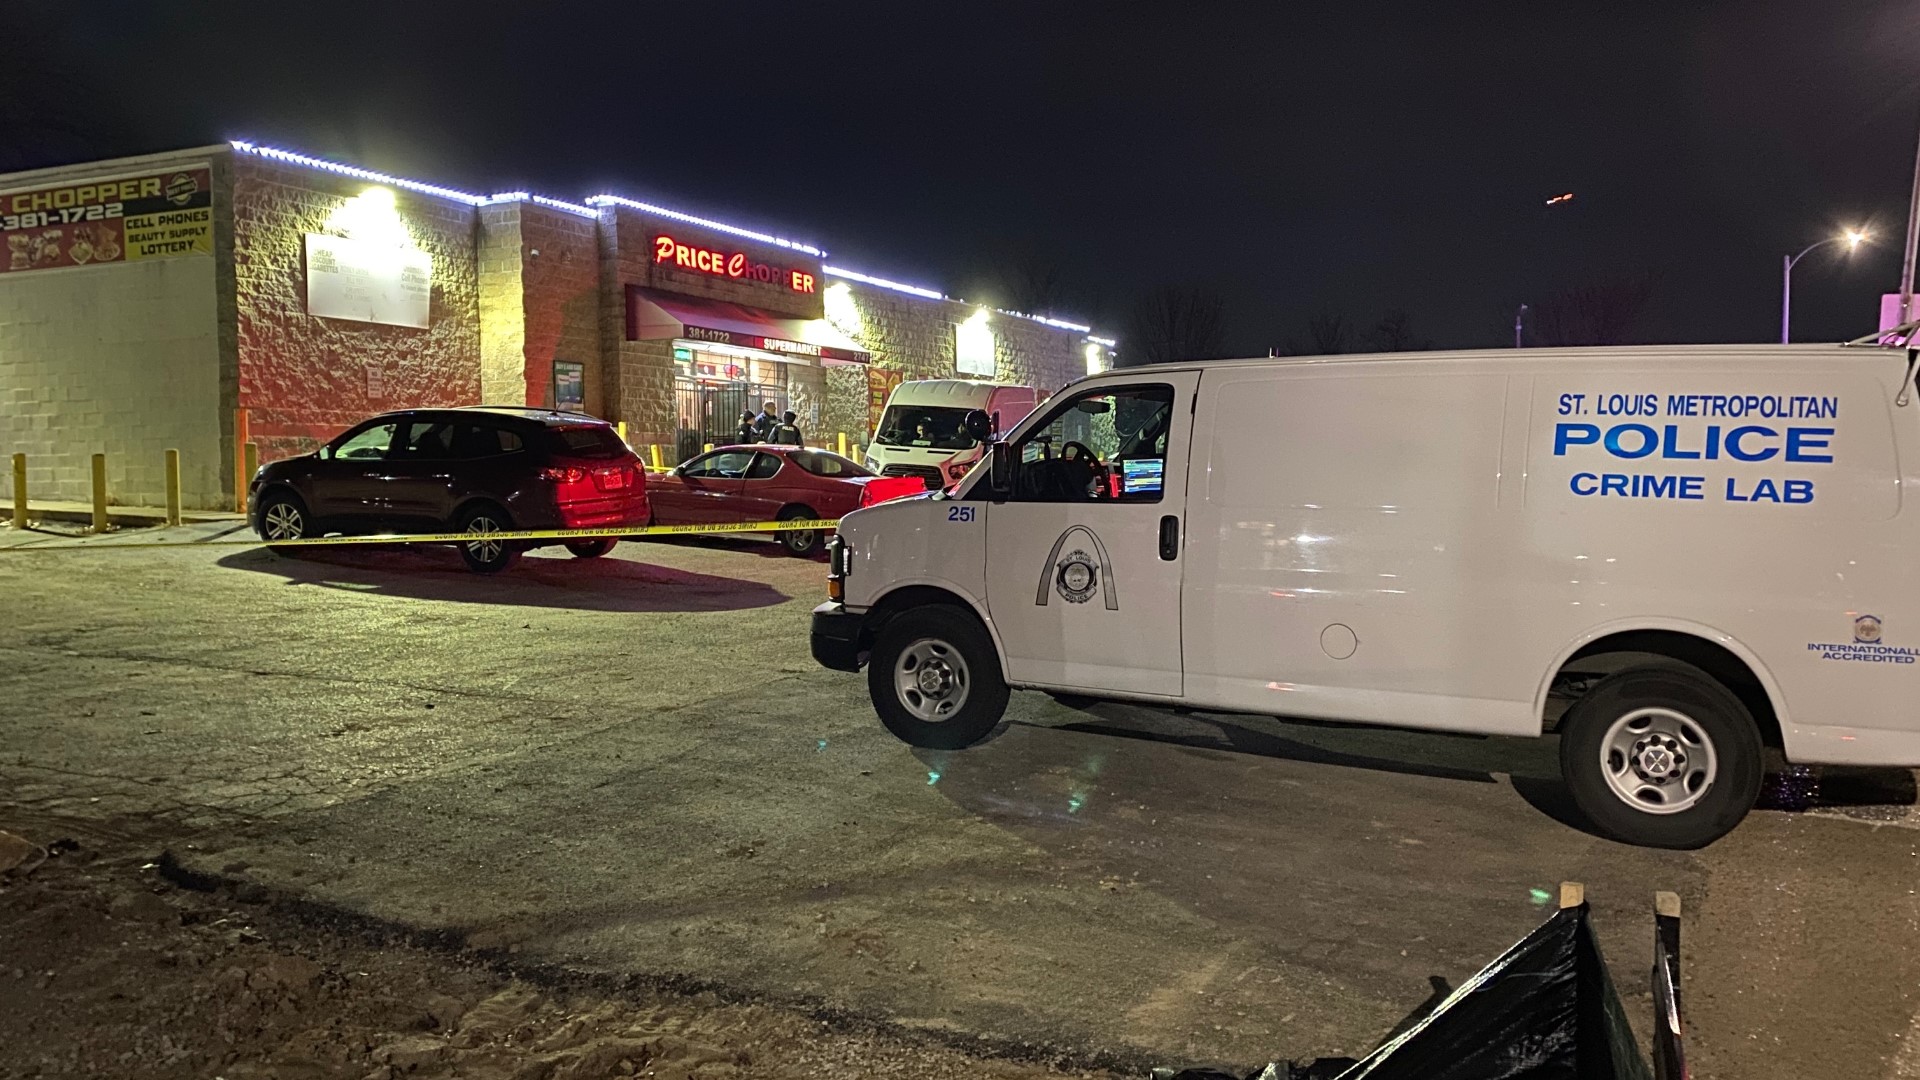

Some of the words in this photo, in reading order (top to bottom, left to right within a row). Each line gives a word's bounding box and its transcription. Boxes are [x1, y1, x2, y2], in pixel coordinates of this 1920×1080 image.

[12, 177, 161, 213] CHOPPER
[126, 218, 155, 230] CELL
[159, 210, 209, 226] PHONES
[128, 230, 165, 243] BEAUTY
[169, 226, 207, 239] SUPPLY
[141, 239, 195, 255] LOTTERY
[656, 236, 725, 275] PRICE
[728, 253, 815, 293] CHOPPER
[688, 326, 730, 343] 381-1722
[763, 338, 822, 356] SUPERMARKET
[853, 352, 870, 361] 2747
[1558, 393, 1588, 416] ST.
[1597, 394, 1658, 416] LOUIS
[1667, 395, 1838, 418] METROPOLITAN
[1553, 423, 1835, 463] POLICE
[1570, 472, 1705, 500] CRIME
[1725, 478, 1815, 504] LAB
[948, 506, 976, 522] 251
[1822, 652, 1915, 664] ACCREDITED
